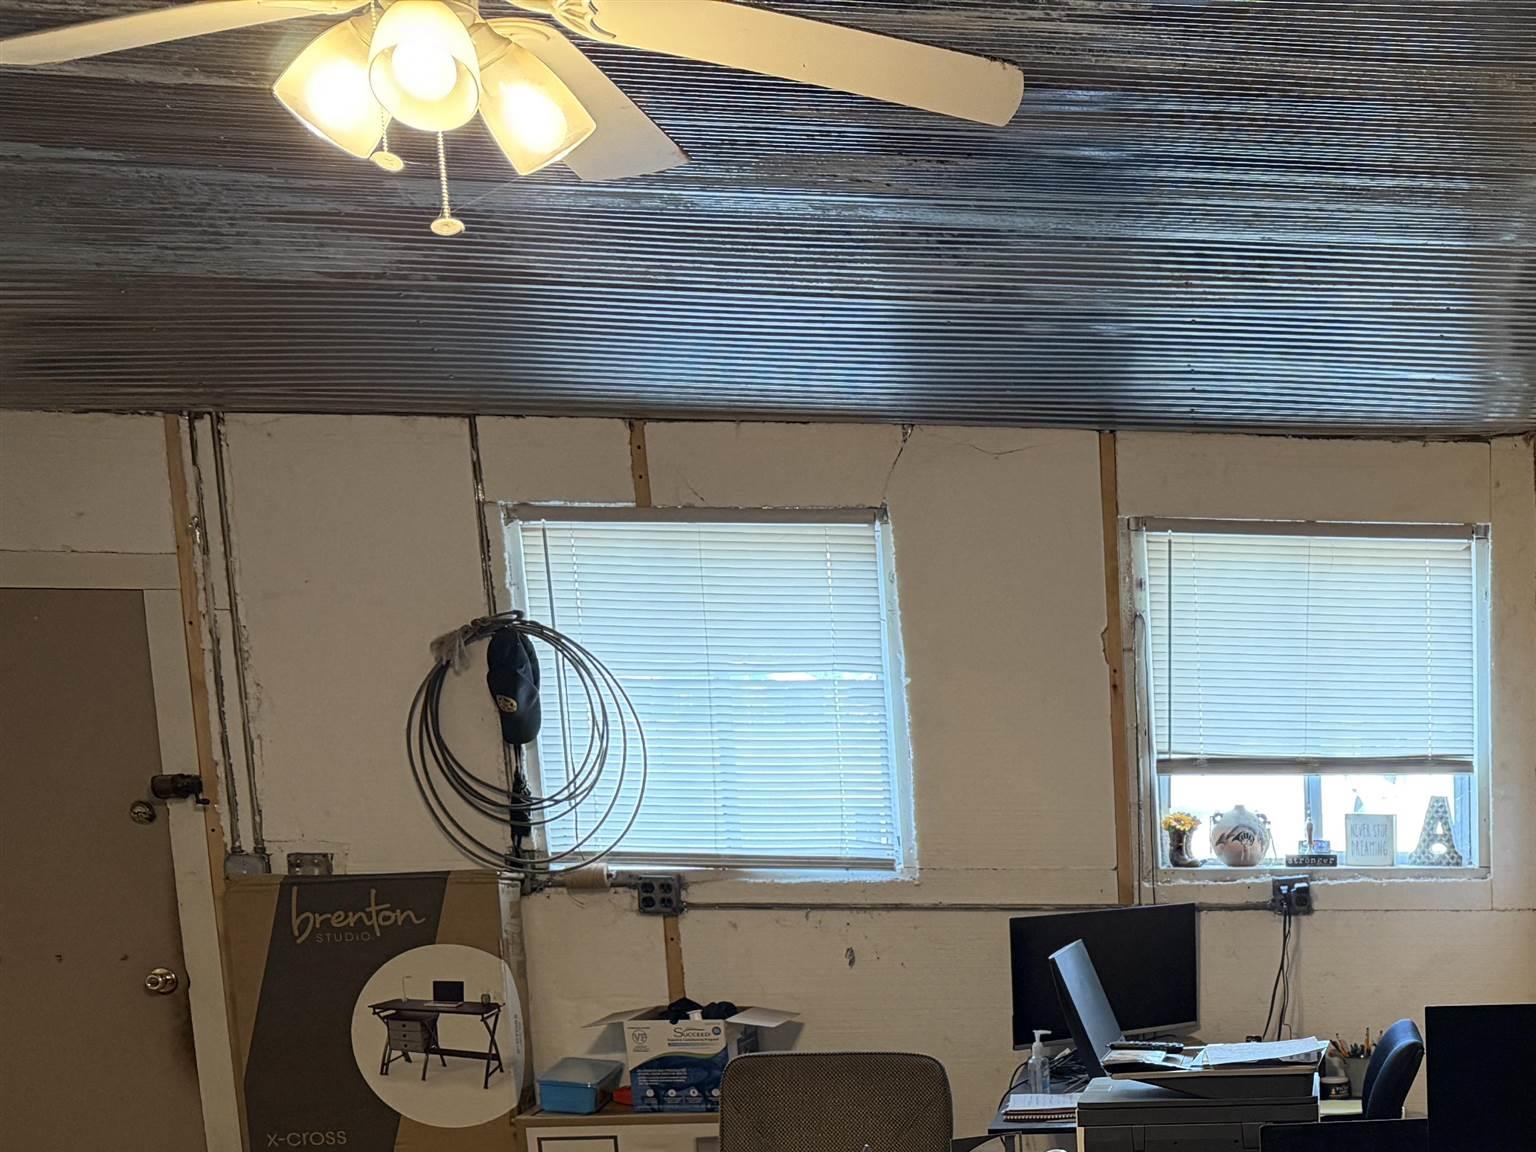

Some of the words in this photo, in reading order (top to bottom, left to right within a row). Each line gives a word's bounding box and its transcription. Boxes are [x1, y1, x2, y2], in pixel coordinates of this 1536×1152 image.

[1351, 823, 1371, 837] NEVER
[1408, 796, 1463, 866] A
[1351, 839, 1389, 856] DREAMING
[1288, 856, 1335, 865] stronger
[291, 886, 426, 944] brenton
[315, 931, 371, 943] STUDIO
[266, 1130, 348, 1147] x-cross
